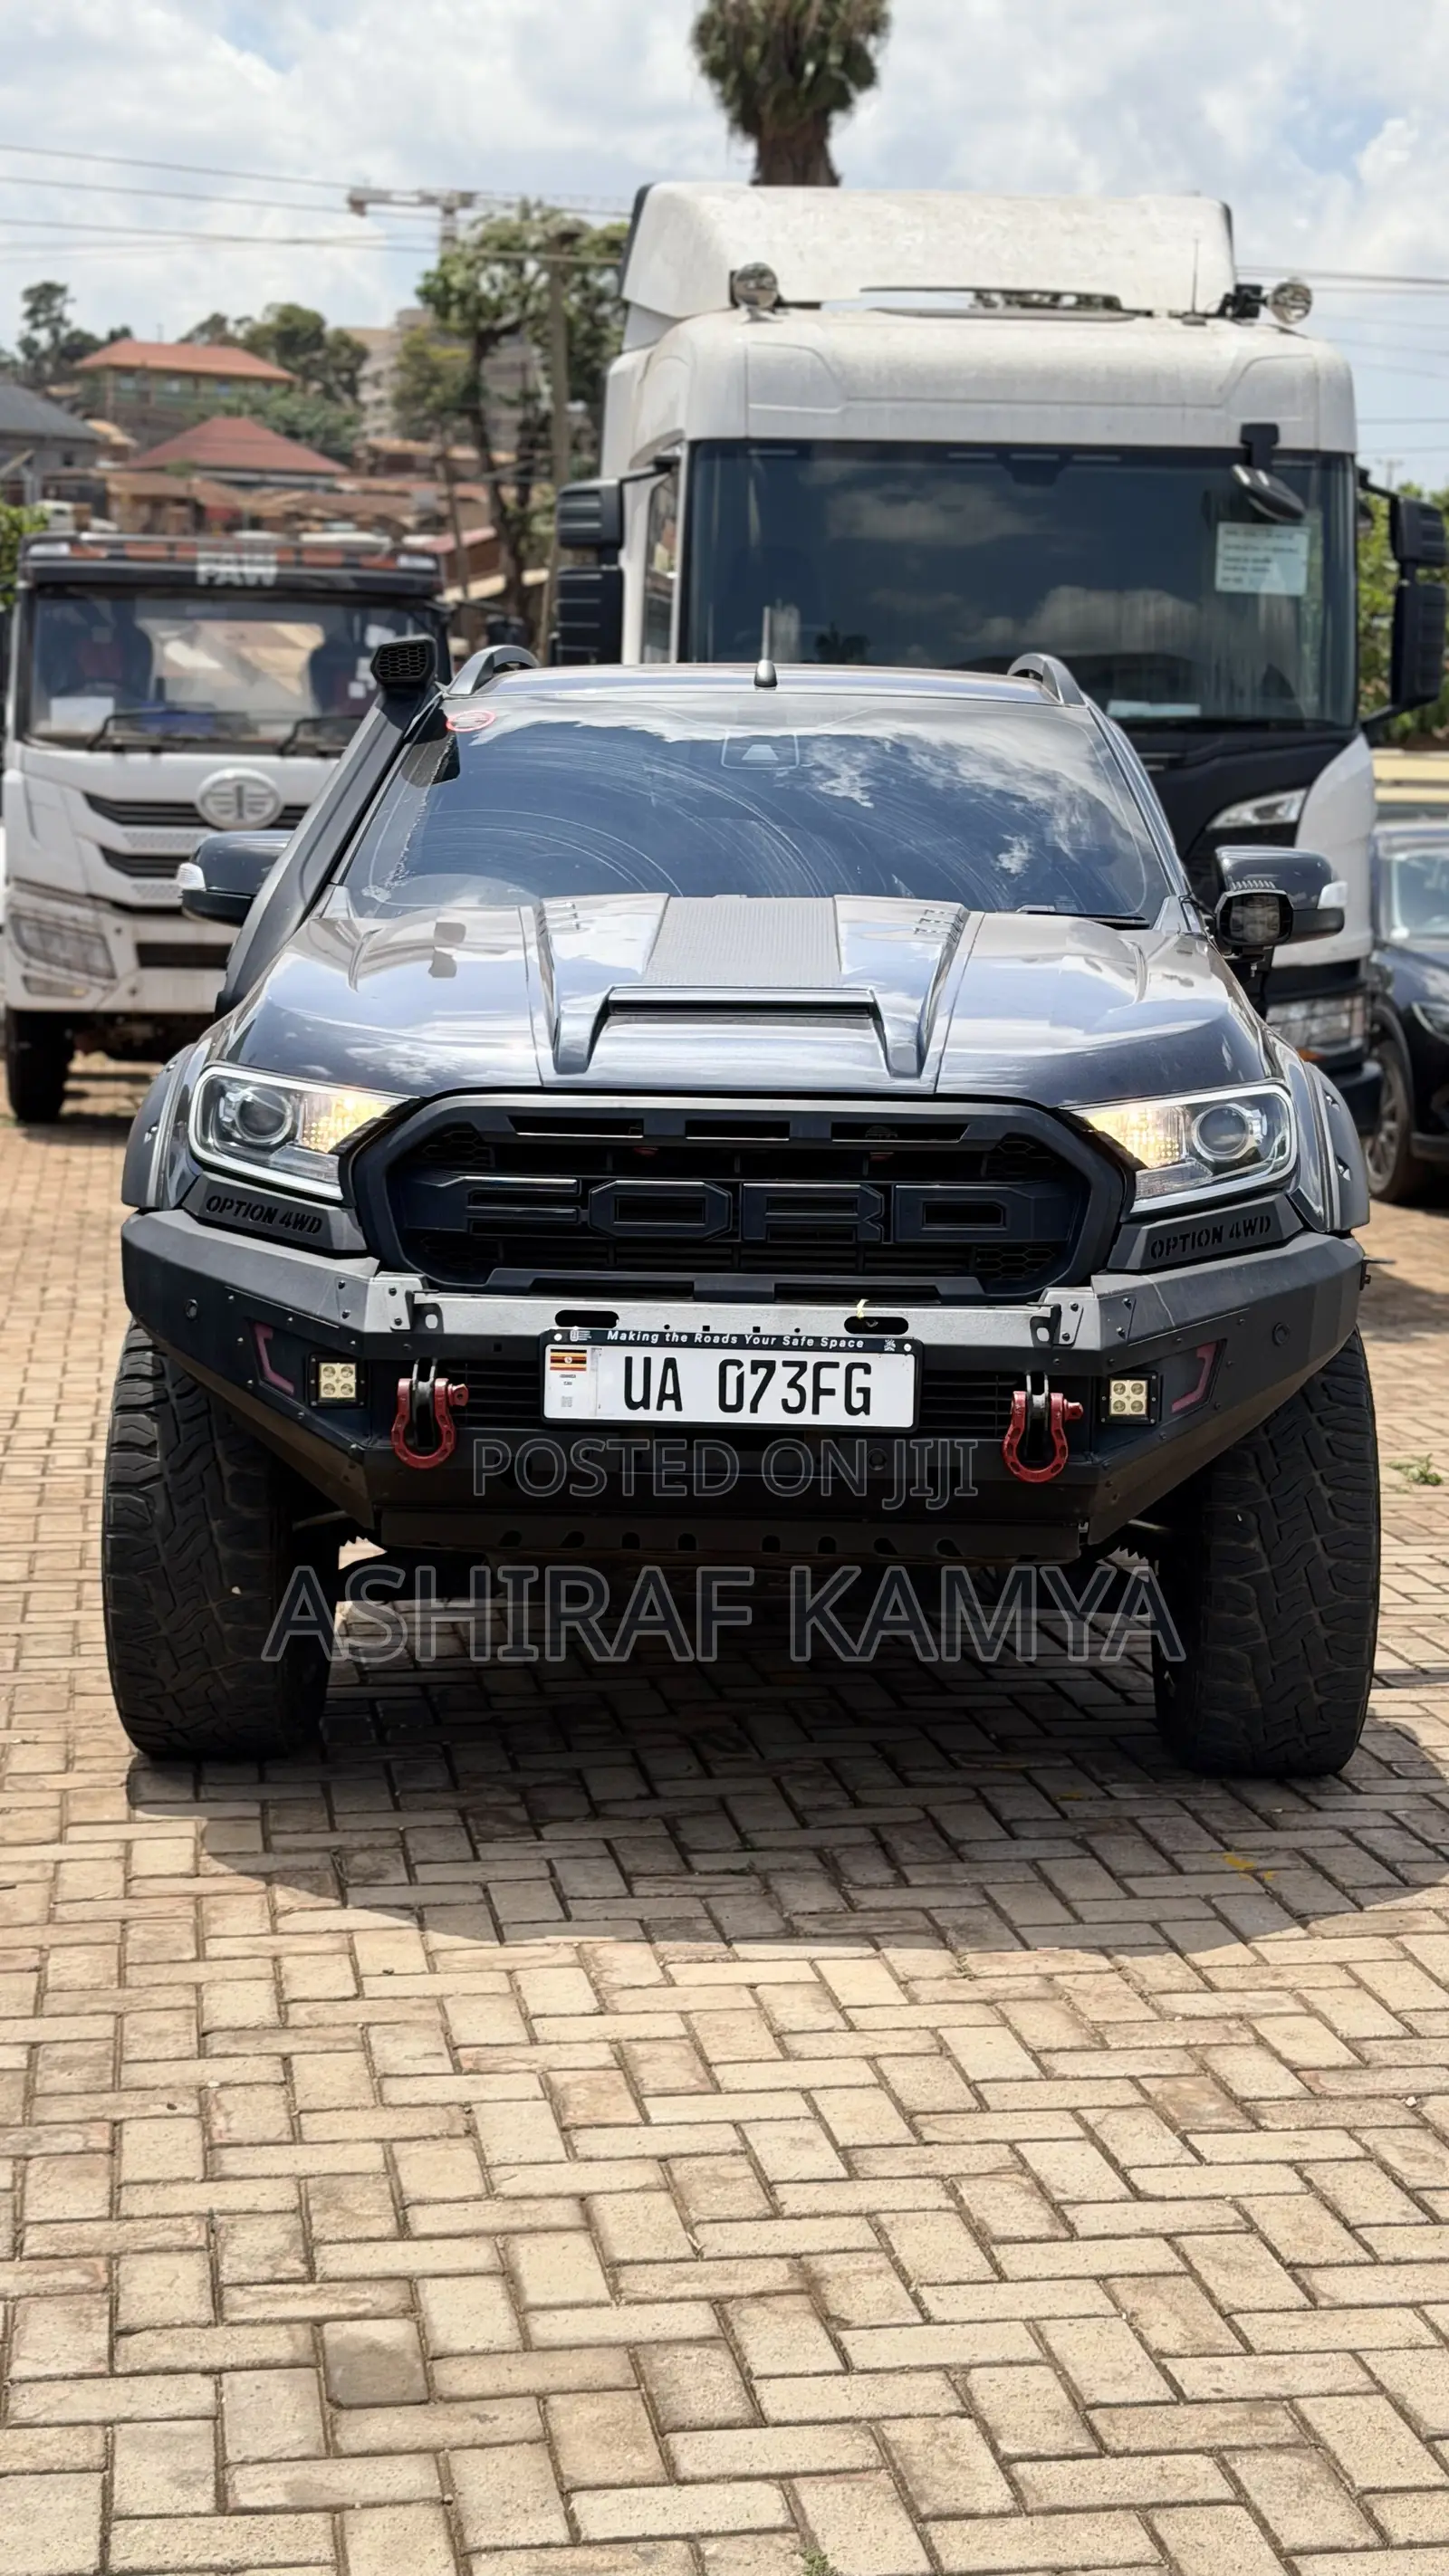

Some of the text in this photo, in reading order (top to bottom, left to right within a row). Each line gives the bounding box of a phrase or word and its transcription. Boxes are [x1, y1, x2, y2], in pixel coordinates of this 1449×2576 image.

[206, 1195, 322, 1234] OPTION 4WD
[433, 1173, 1041, 1245] FORD
[1150, 1215, 1271, 1259] OPTION 4WD
[607, 1330, 865, 1349] Making the Roads Your Safe Space
[624, 1356, 872, 1416] UA 073FG
